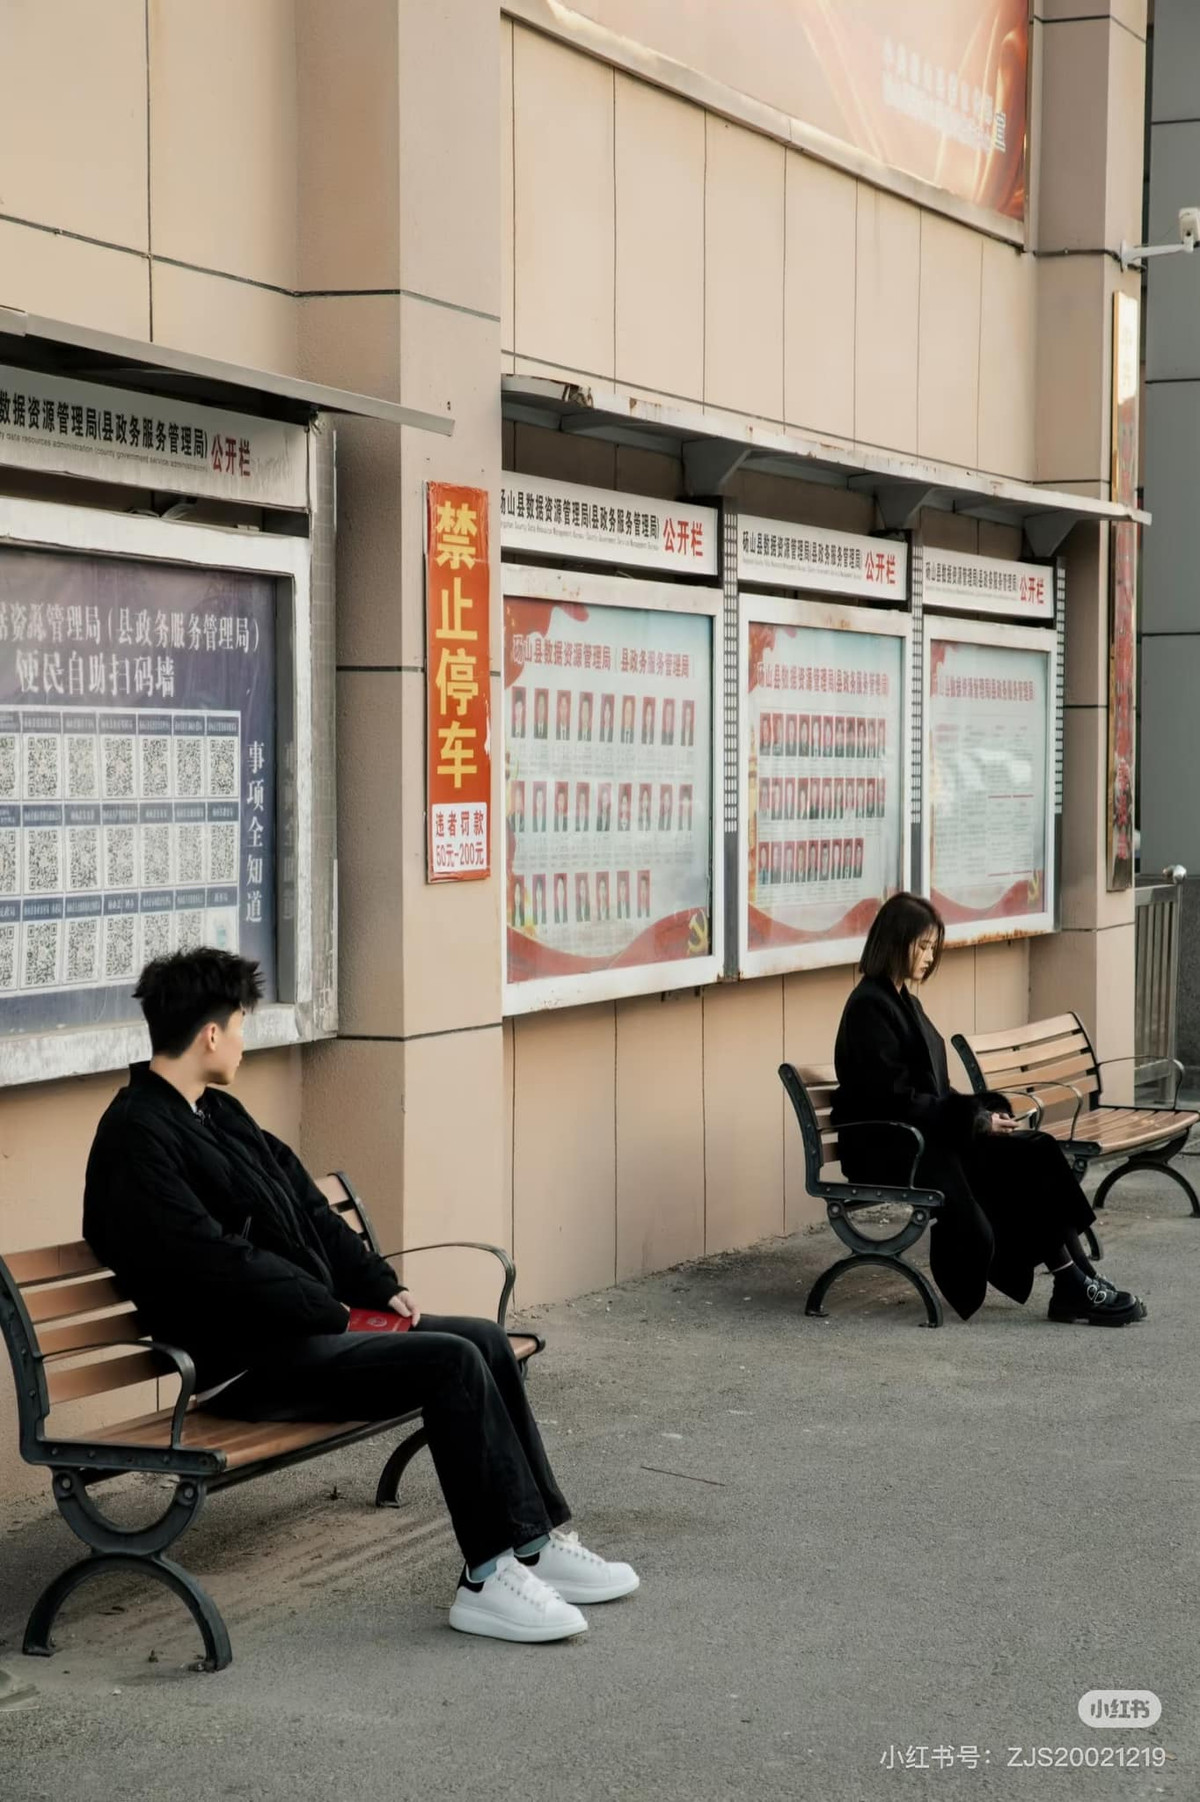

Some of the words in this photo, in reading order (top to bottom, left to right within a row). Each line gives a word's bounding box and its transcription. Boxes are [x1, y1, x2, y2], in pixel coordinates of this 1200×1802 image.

[211, 432, 251, 477] 公开栏
[663, 517, 704, 557] 公开栏
[865, 550, 896, 585] 公开栏
[1020, 574, 1045, 606] 公开栏
[436, 501, 479, 789] 禁止停车
[15, 648, 176, 698] 便民自助扫码墙
[245, 740, 265, 923] 事项全知道
[435, 809, 484, 838] 违者罚款
[435, 841, 485, 869] 50元-200元
